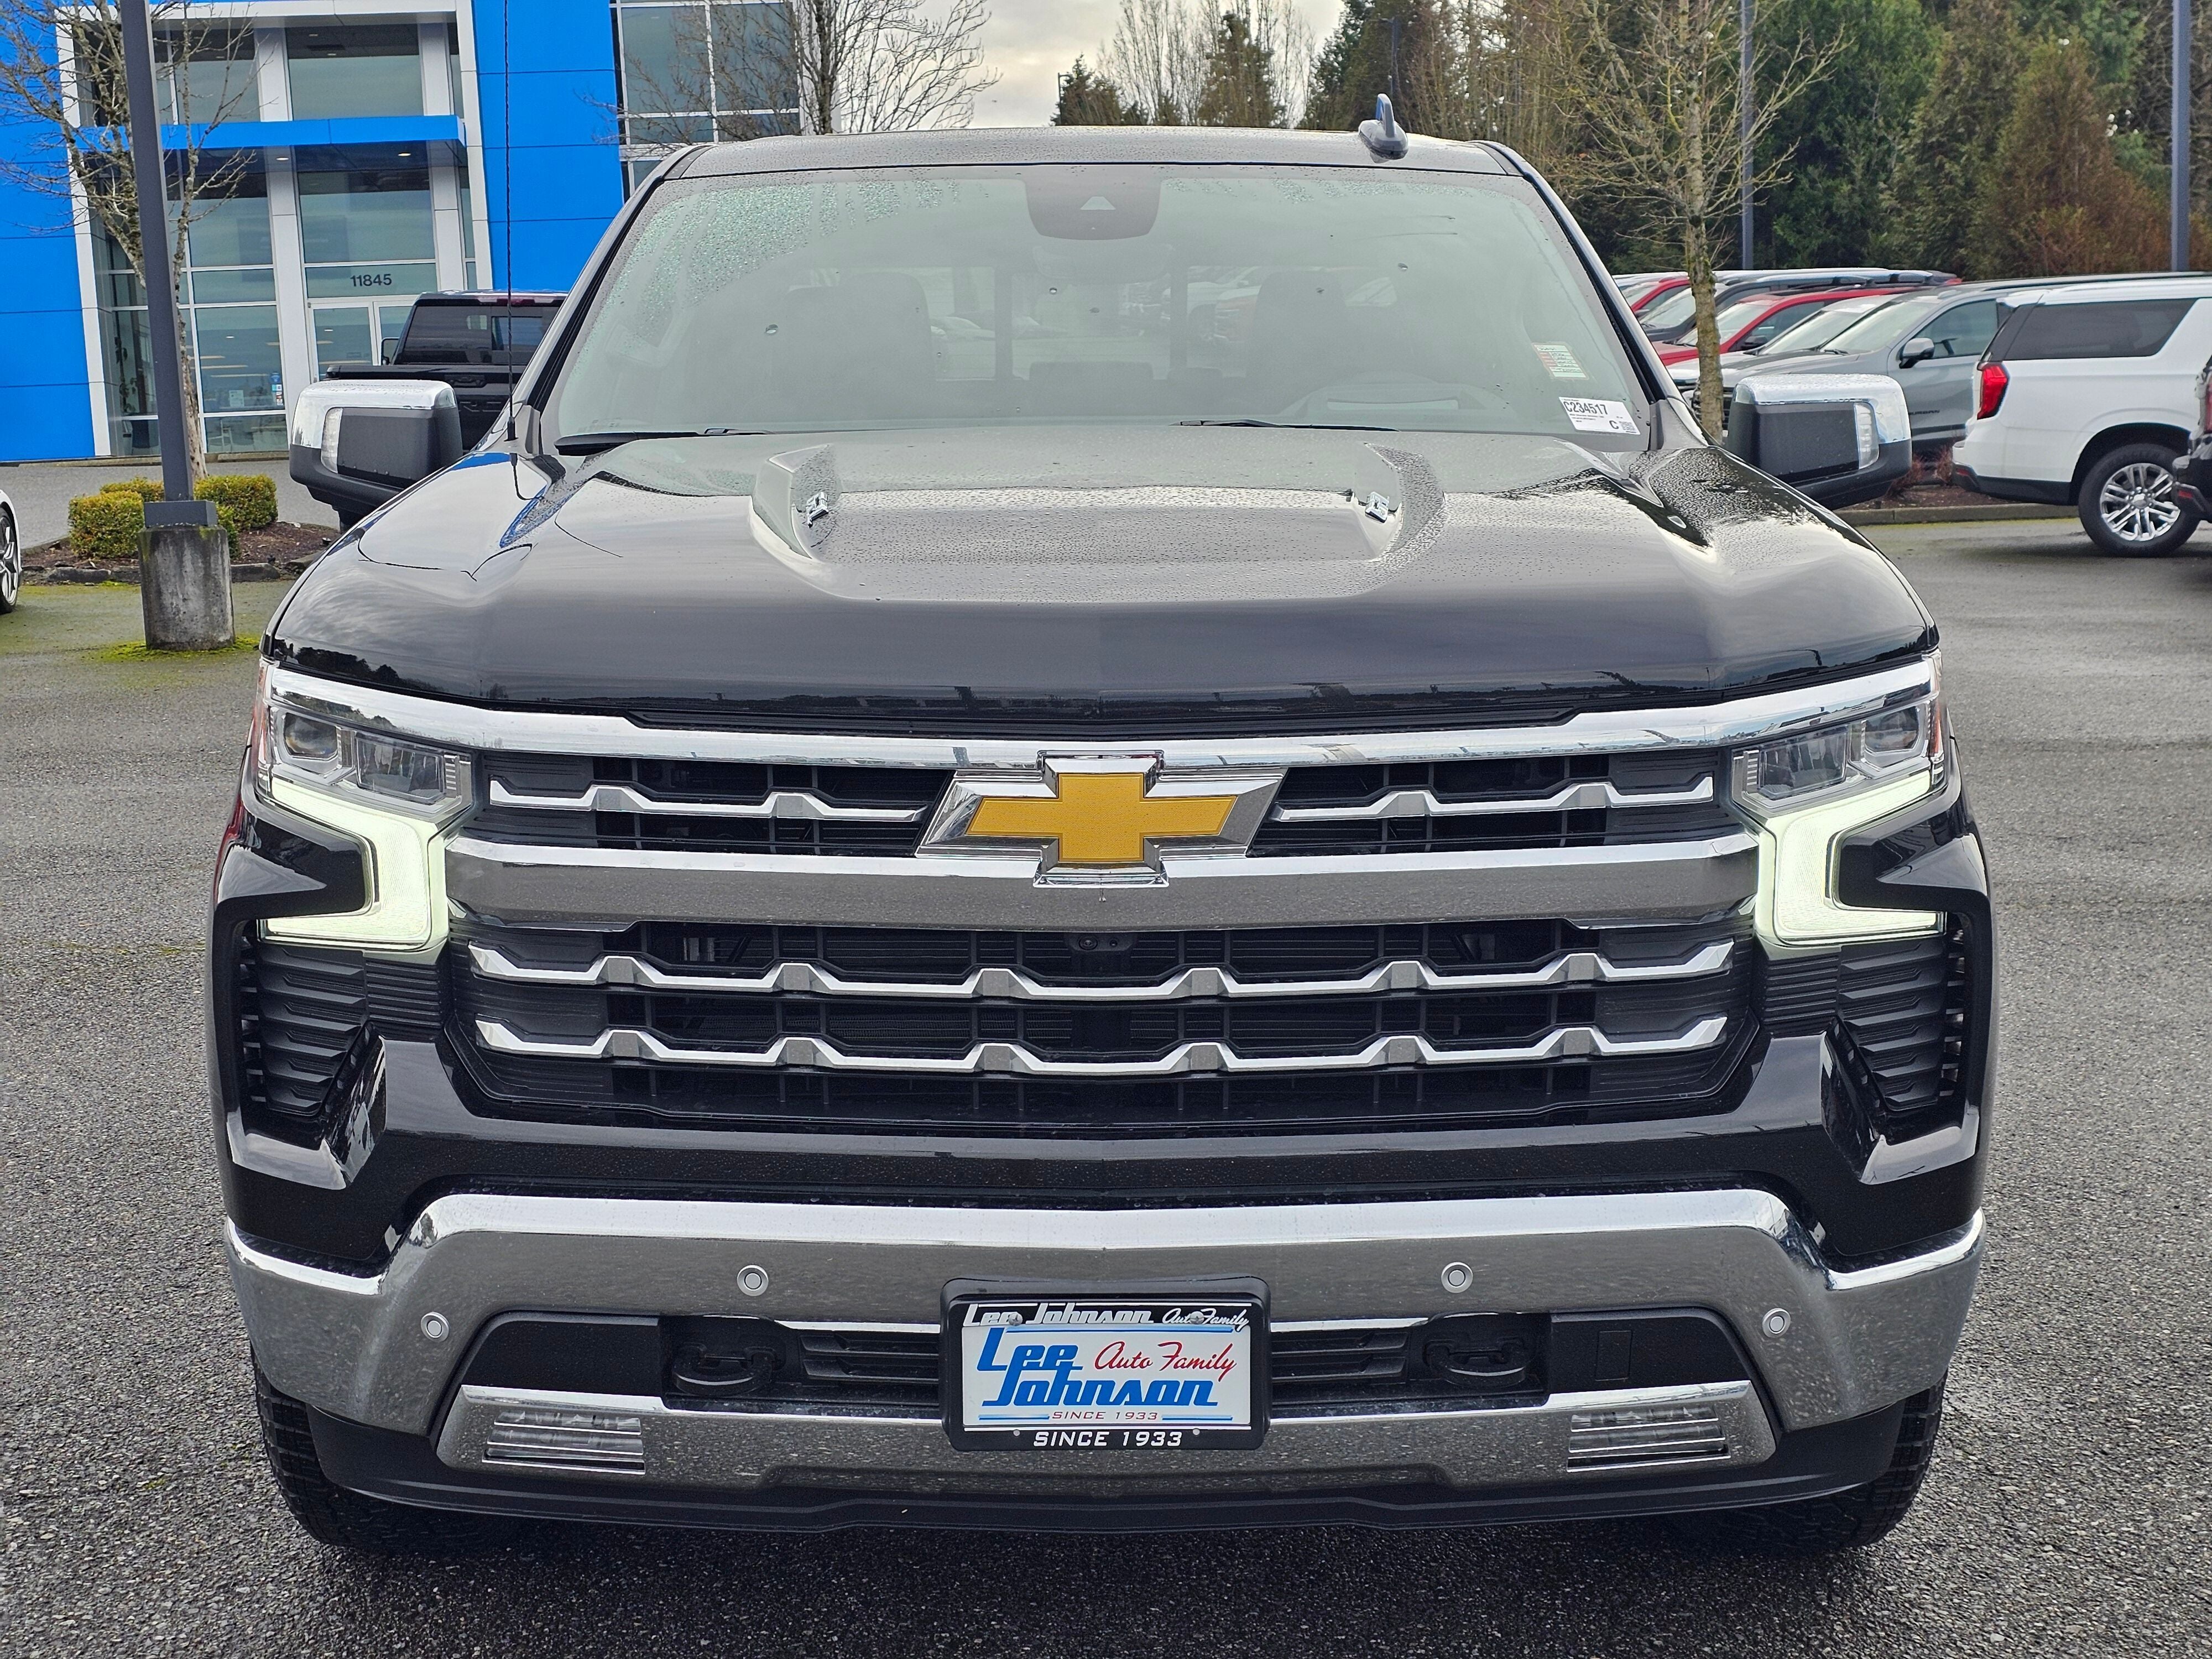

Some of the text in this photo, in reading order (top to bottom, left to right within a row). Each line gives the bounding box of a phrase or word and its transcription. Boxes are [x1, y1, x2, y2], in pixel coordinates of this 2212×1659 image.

[349, 273, 392, 286] 11845
[1563, 401, 1608, 415] C234517
[1609, 420, 1619, 430] C
[1025, 1302, 1154, 1324] Johnson
[1162, 1308, 1201, 1324] Aut
[1199, 1308, 1249, 1332] Family
[977, 1327, 1237, 1383] Lee Auto Family
[982, 1365, 1218, 1406] Johnson
[1052, 1411, 1158, 1420] SINCE 1933
[1033, 1431, 1182, 1447] SINCE 1933
